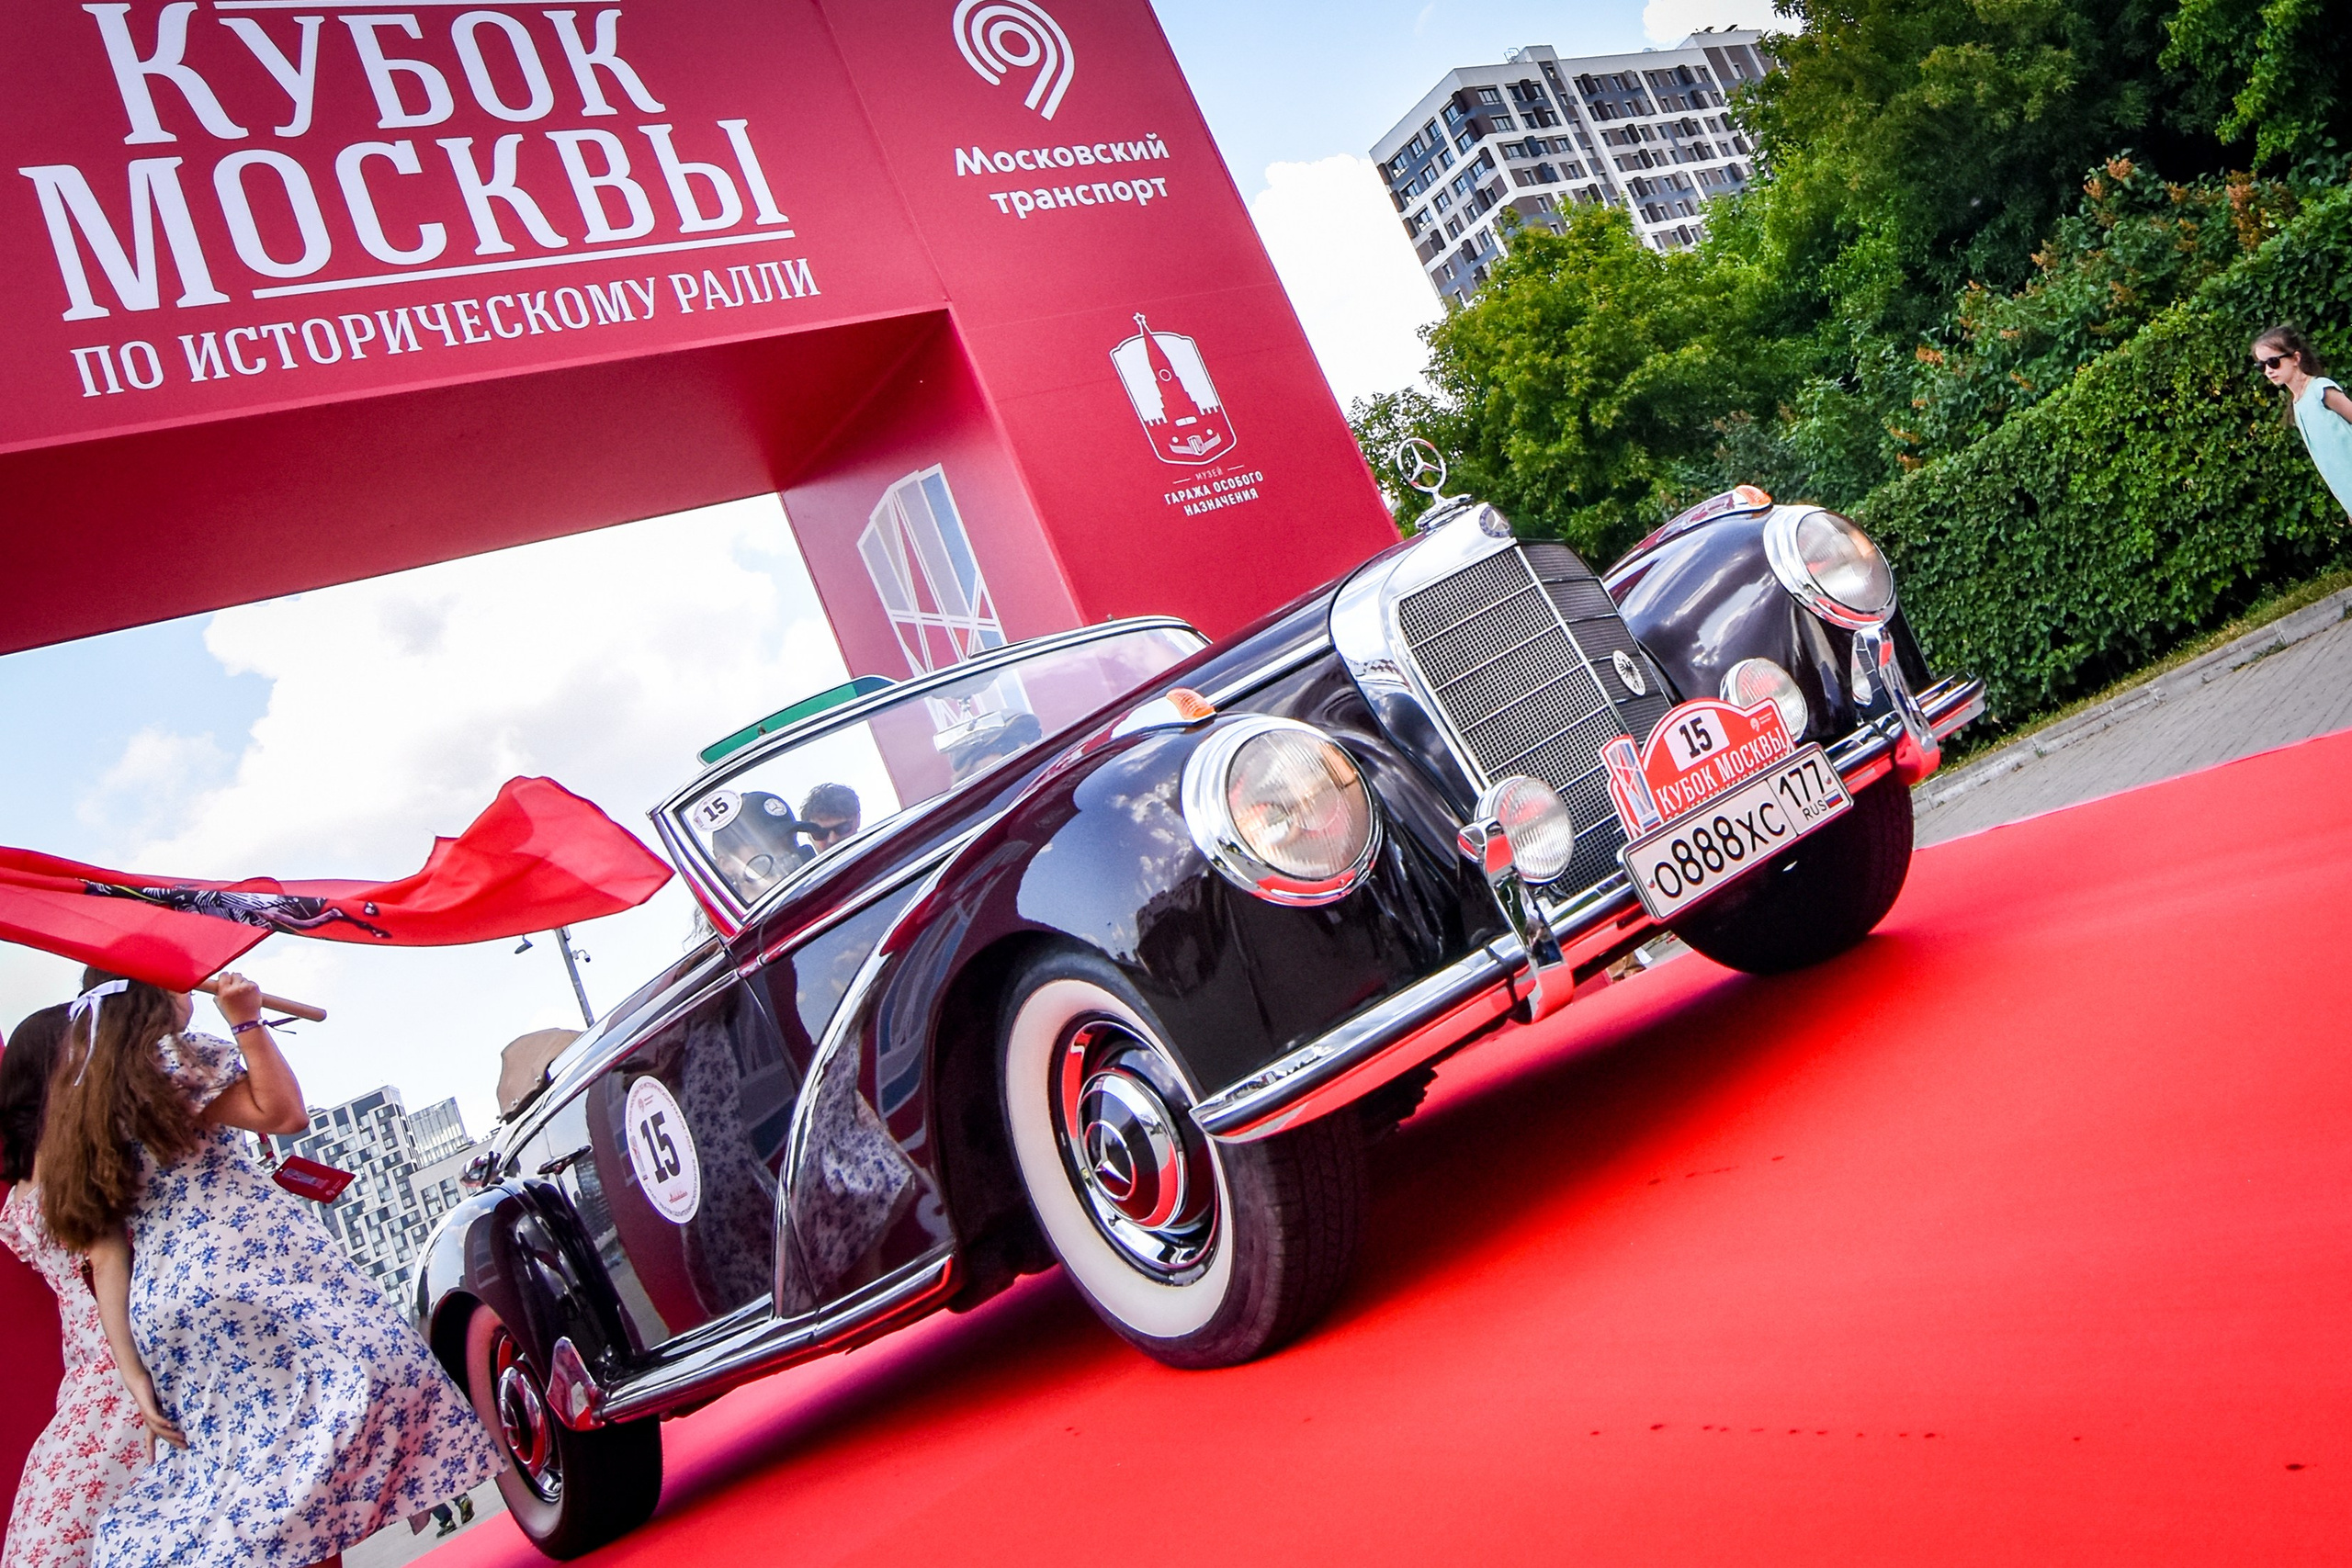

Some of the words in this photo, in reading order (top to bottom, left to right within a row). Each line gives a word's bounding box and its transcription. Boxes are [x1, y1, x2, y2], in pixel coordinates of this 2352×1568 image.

[82, 1, 667, 145] КУБОК
[956, 133, 1170, 177] Московский
[18, 119, 790, 321] МОСКВЫ
[989, 177, 1168, 220] транспорт
[71, 340, 164, 397] ПО
[178, 276, 657, 383] ИСТОРИЧЕСКОМУ
[667, 257, 822, 314] РАЛЛИ
[1163, 484, 1212, 505] ГАРАЖА
[1212, 470, 1264, 493] ОСОБОГО
[1194, 466, 1224, 481] МУЗЕЙ
[1183, 487, 1260, 517] НАЗНАЧЕНИЯ
[1679, 716, 1713, 760] 15
[1656, 764, 1719, 815] КУБОК
[1713, 727, 1787, 784] МОСКВЫ
[1779, 758, 1826, 808] 177
[702, 796, 729, 823] 15
[1802, 799, 1828, 821] RUS
[639, 1110, 682, 1185] 15
